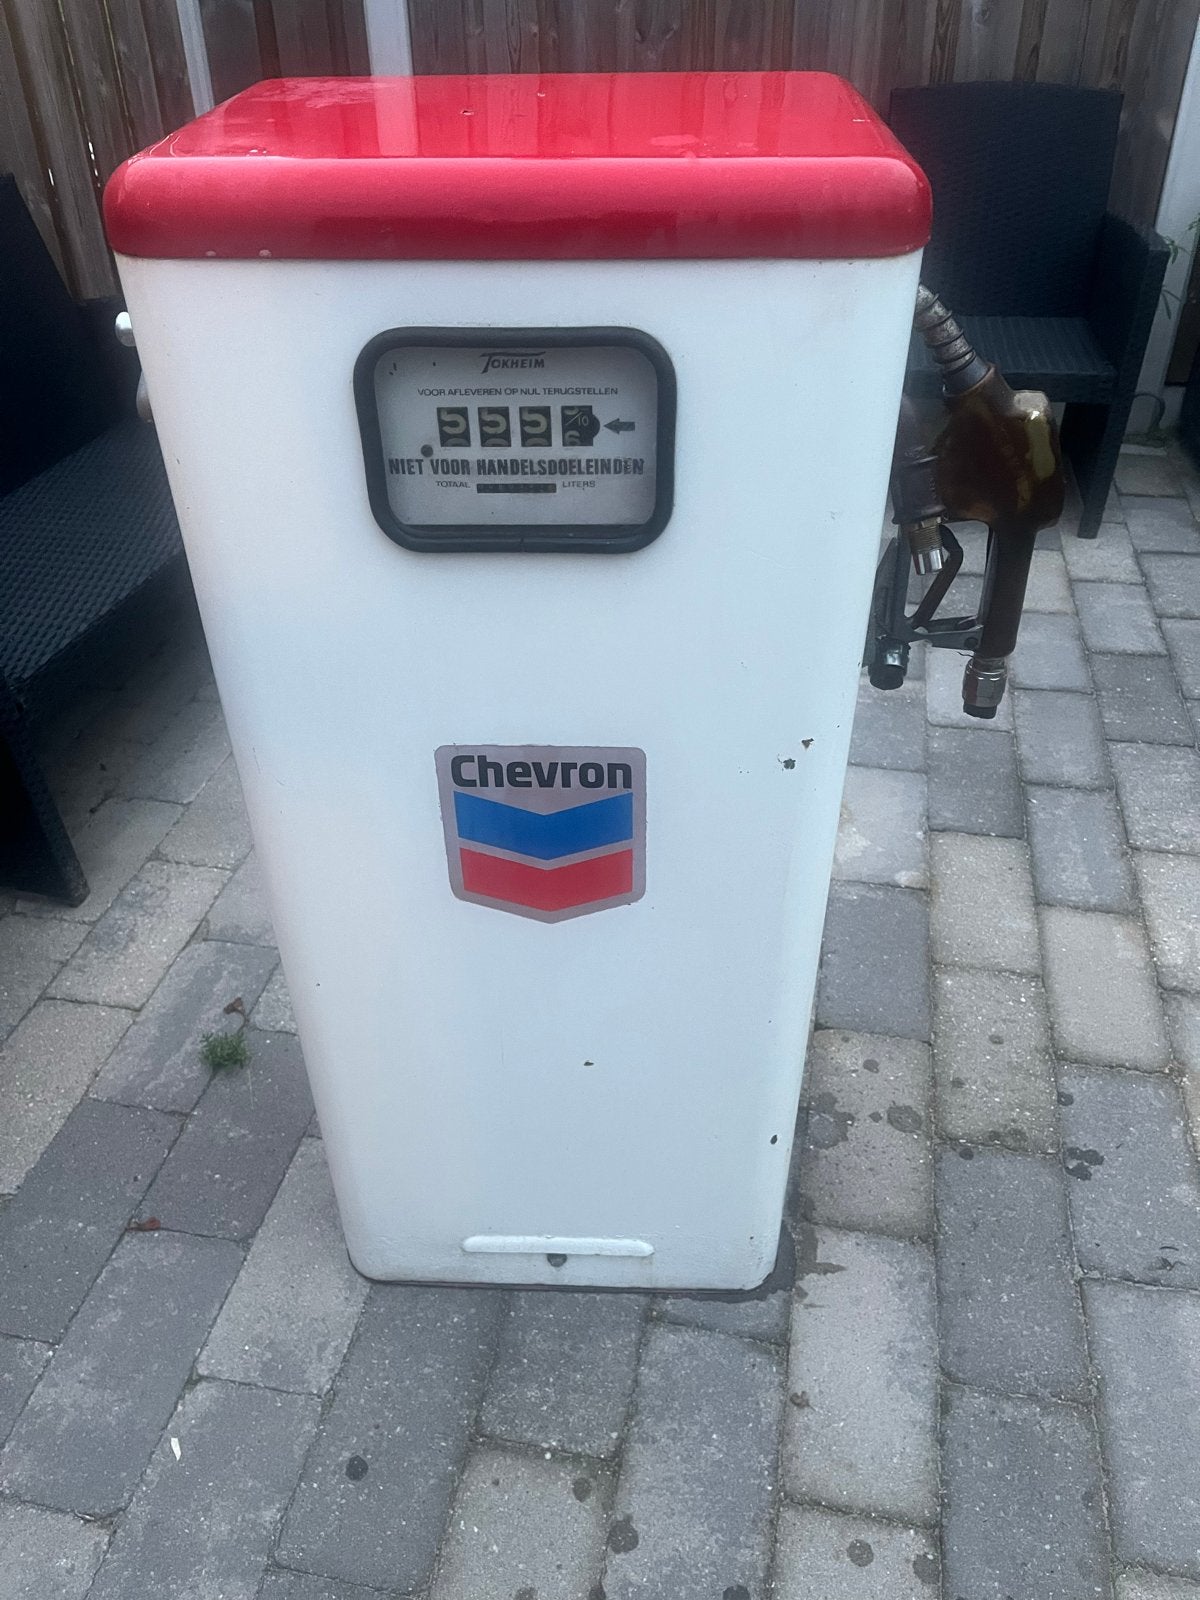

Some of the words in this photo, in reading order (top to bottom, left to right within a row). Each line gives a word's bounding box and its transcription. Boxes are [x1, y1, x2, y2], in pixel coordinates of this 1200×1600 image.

[480, 351, 546, 374] TOKHEIM
[418, 388, 446, 396] VOOR
[448, 388, 502, 396] AFLEVEREN
[504, 387, 519, 395] OP
[520, 387, 541, 395] NUL
[543, 387, 618, 395] TERUGSTELLEN
[388, 458, 424, 475] NIET
[430, 458, 471, 475] VOOR
[477, 458, 645, 476] HANDELSDOELEINDEN
[436, 480, 471, 488] TOTAAL
[562, 480, 596, 489] LITERS
[451, 755, 632, 789] Chevron
